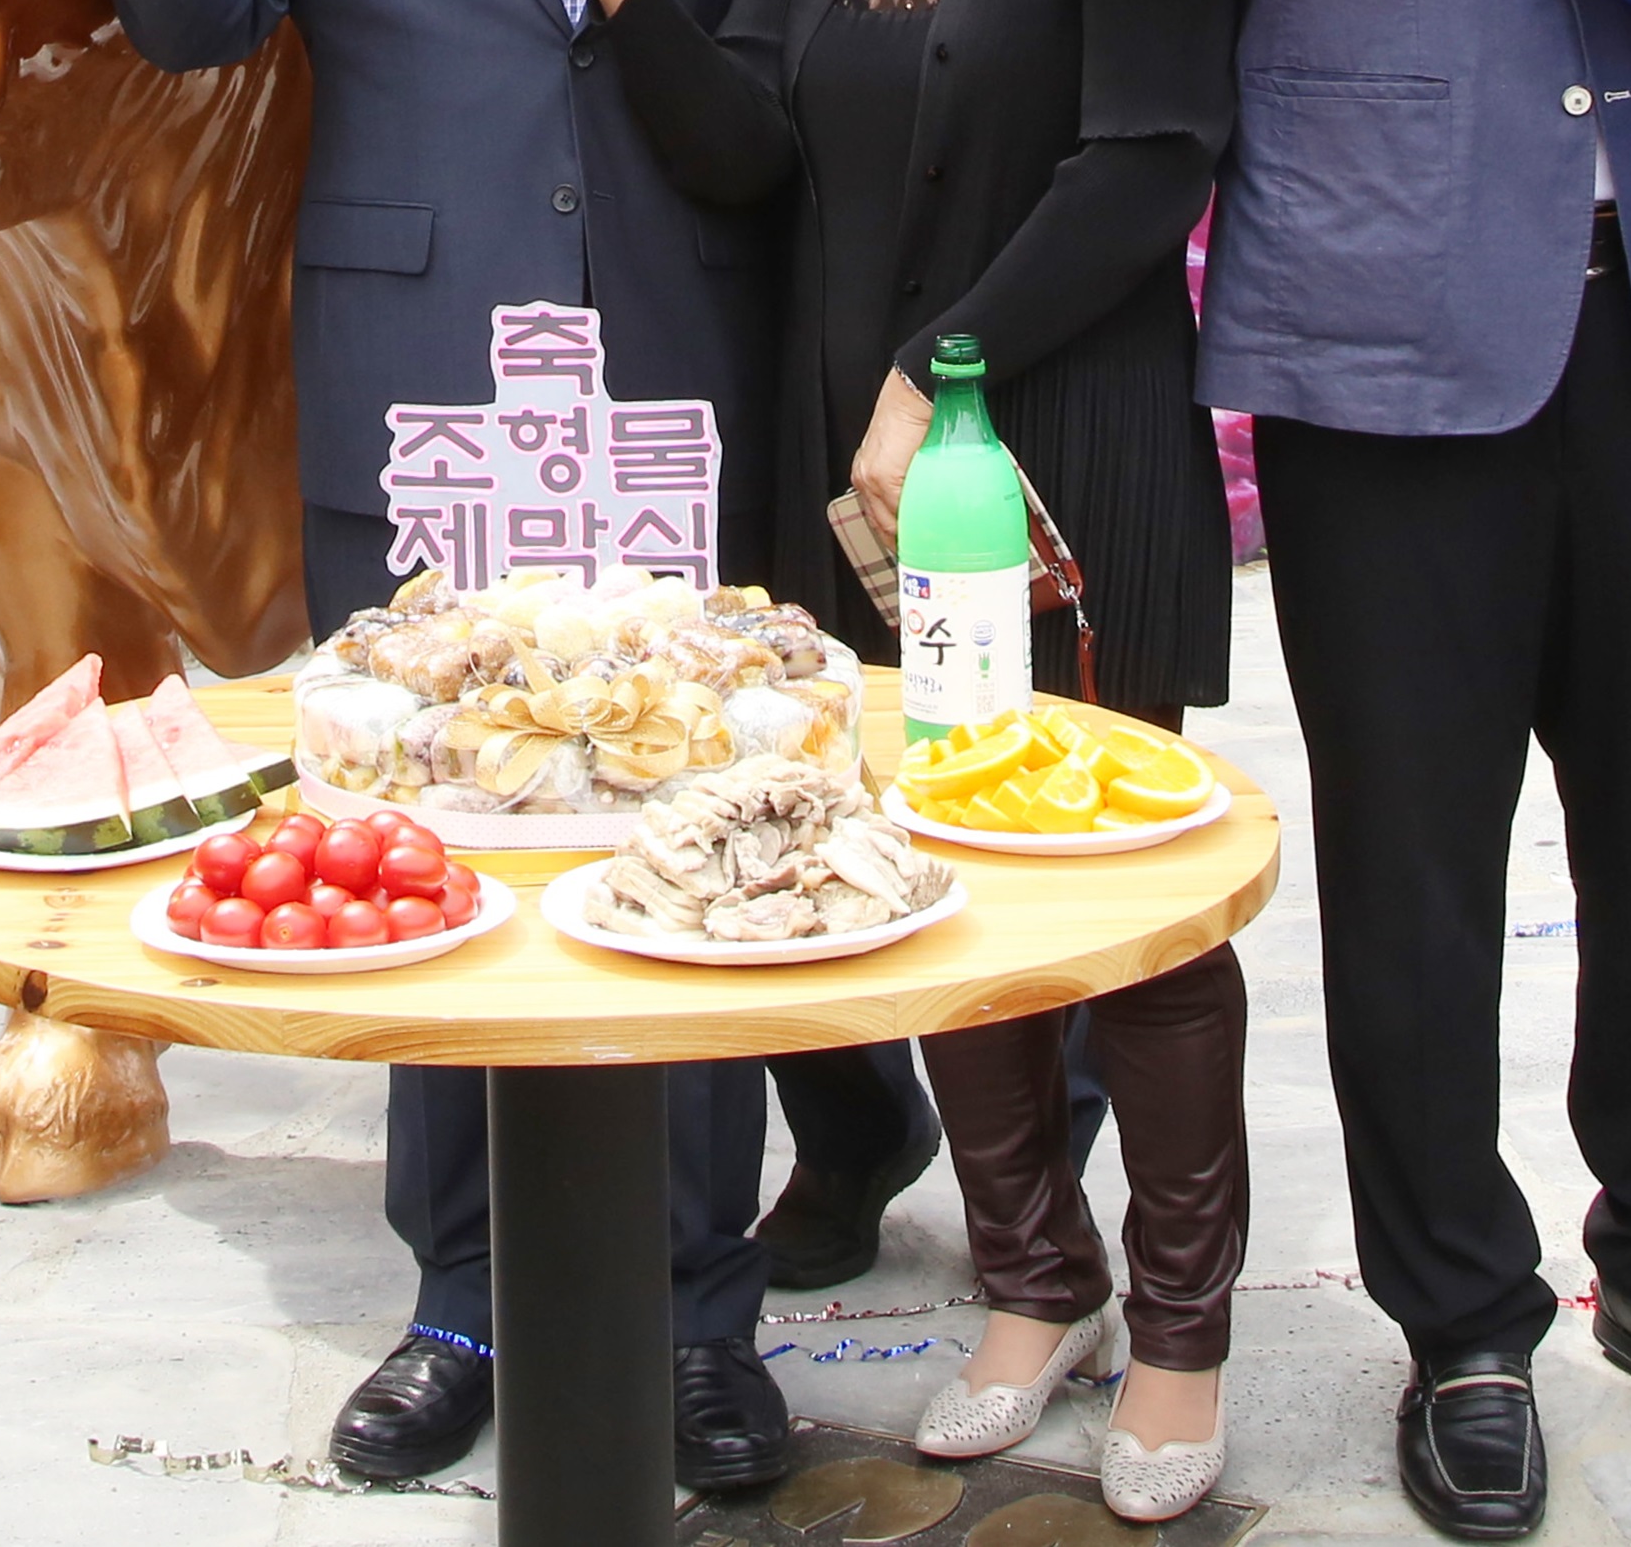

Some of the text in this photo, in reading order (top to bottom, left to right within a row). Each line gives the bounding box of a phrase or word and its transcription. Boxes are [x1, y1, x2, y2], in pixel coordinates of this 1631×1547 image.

[497, 311, 598, 396] 축
[390, 405, 712, 494] 조형물
[395, 502, 710, 591] 제막식
